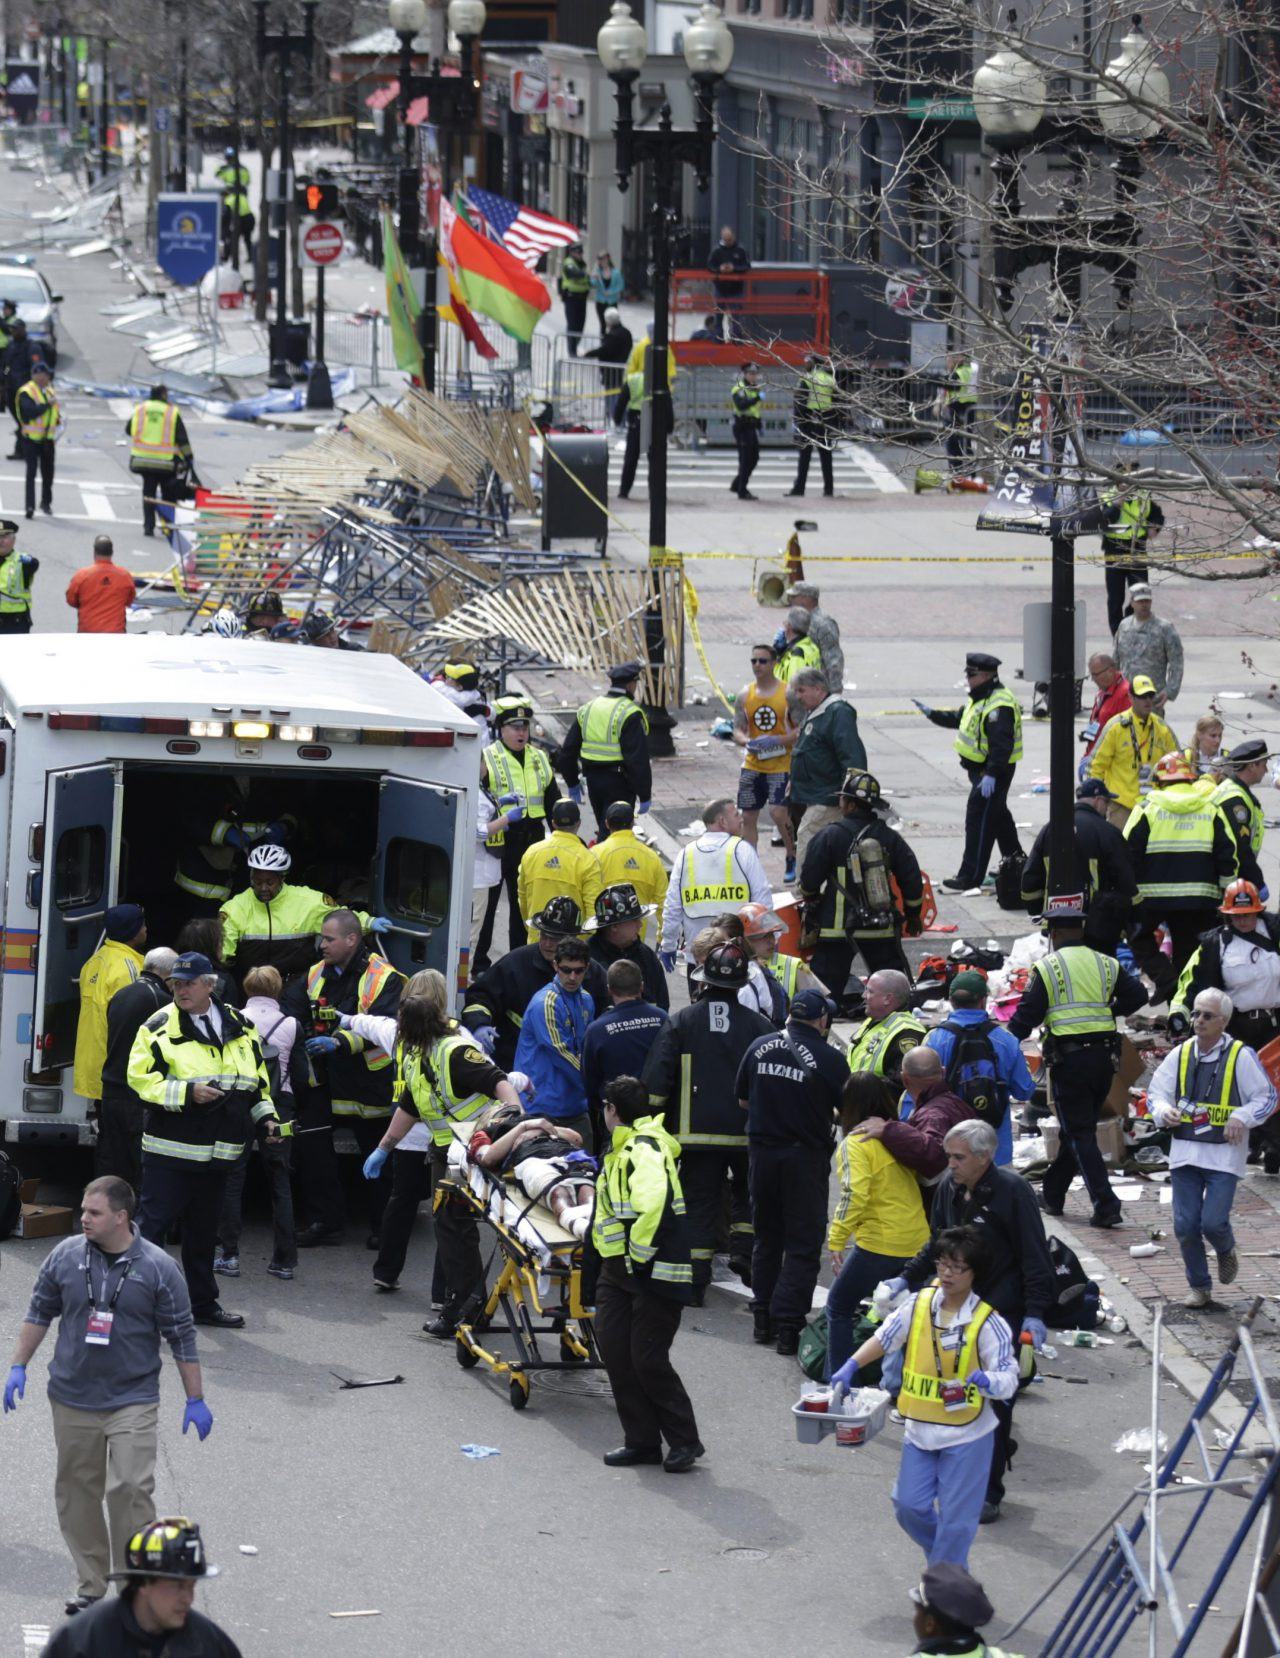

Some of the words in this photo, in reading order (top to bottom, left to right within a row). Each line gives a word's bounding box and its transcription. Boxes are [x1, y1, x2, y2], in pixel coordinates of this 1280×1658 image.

[997, 445, 1026, 500] 203
[605, 1017, 661, 1032] Broadway
[754, 1038, 790, 1060] BOSTO
[798, 1044, 817, 1070] FIRE
[757, 1062, 805, 1083] HAZMAT
[920, 1379, 933, 1397] IV
[185, 1540, 200, 1564] 7
